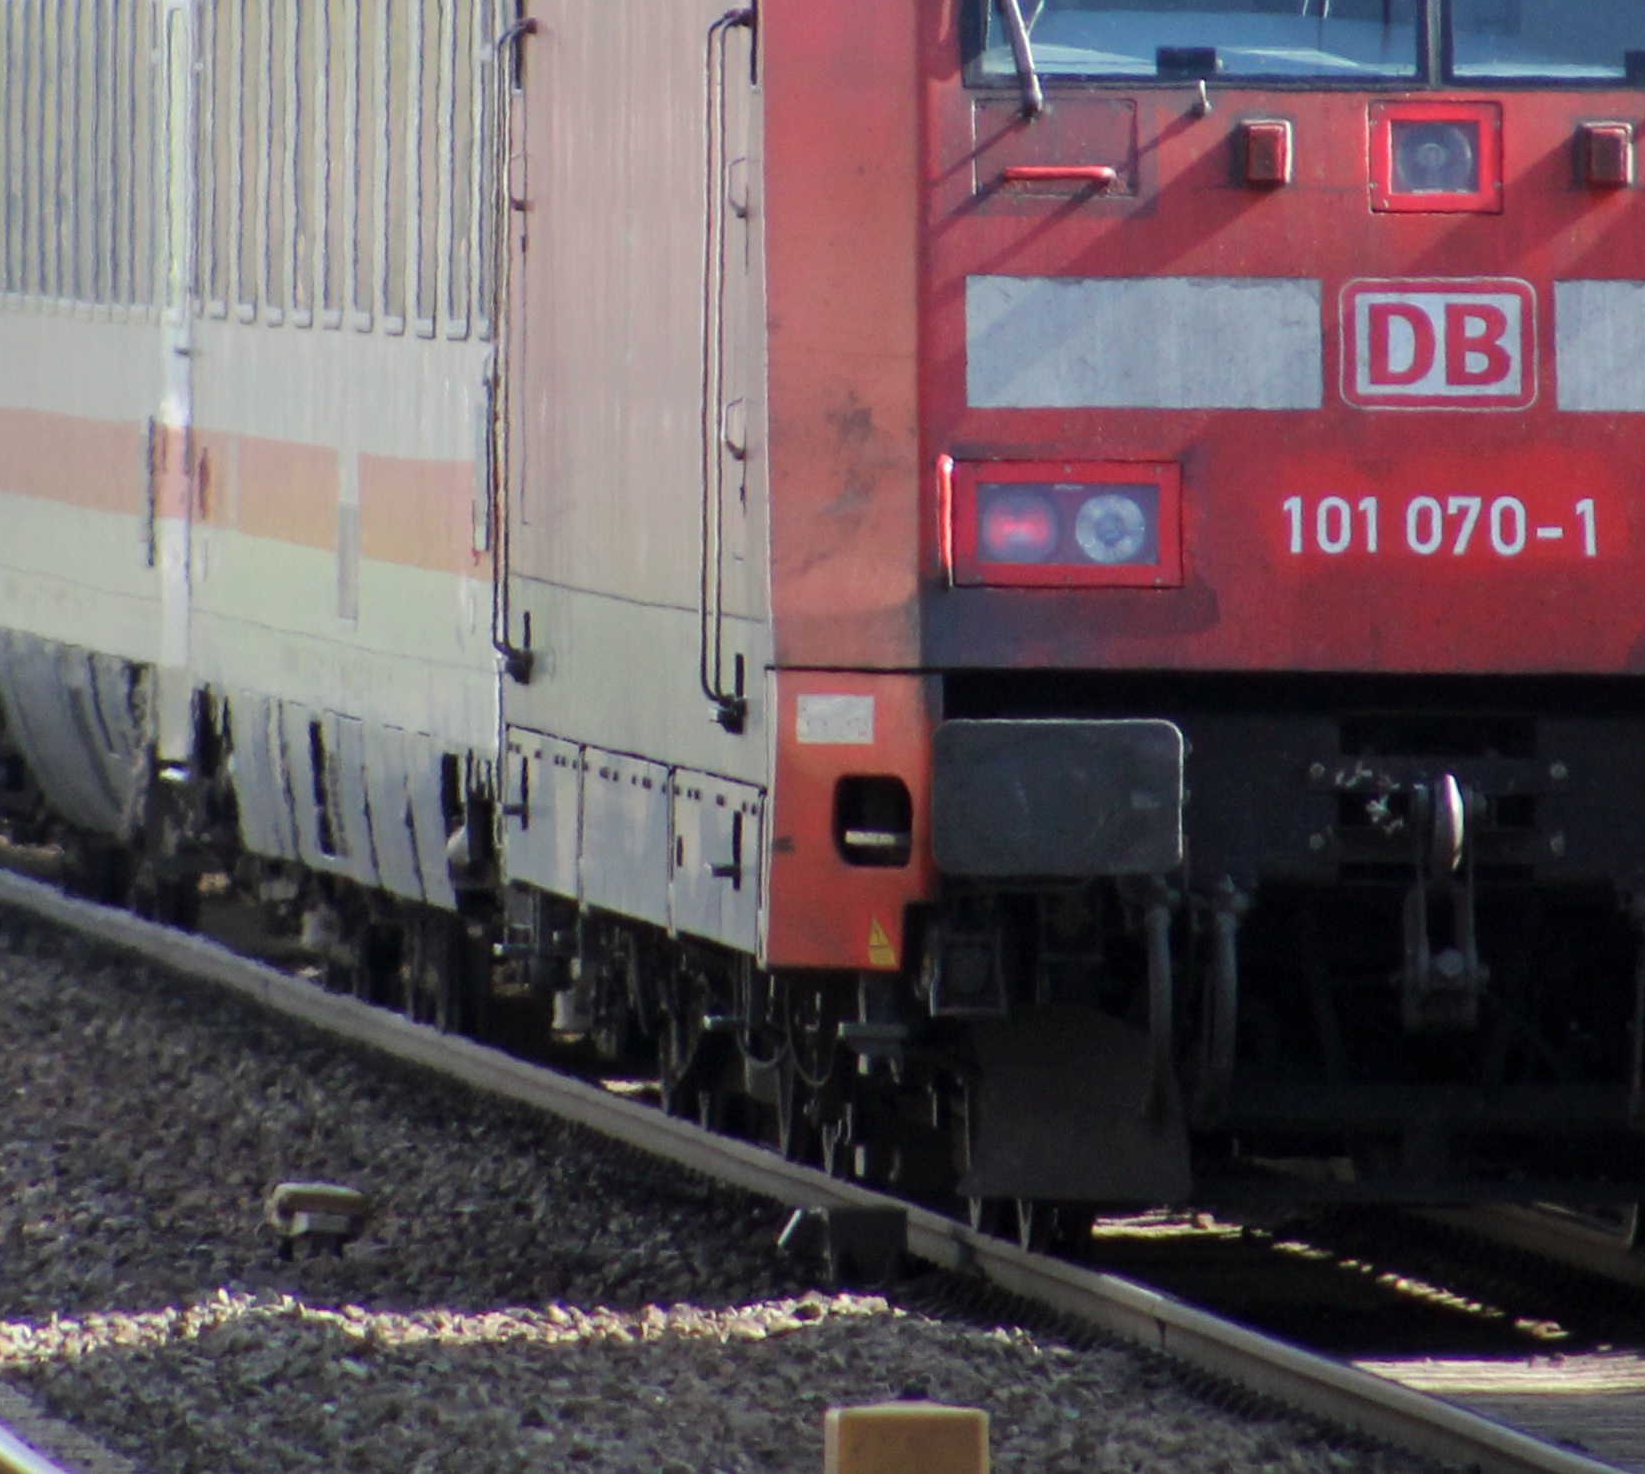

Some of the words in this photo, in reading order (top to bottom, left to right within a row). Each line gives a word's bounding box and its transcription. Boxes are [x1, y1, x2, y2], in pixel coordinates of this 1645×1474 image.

[1369, 303, 1511, 385] DB
[1283, 495, 1378, 553] 101
[1406, 495, 1597, 556] 070-1
